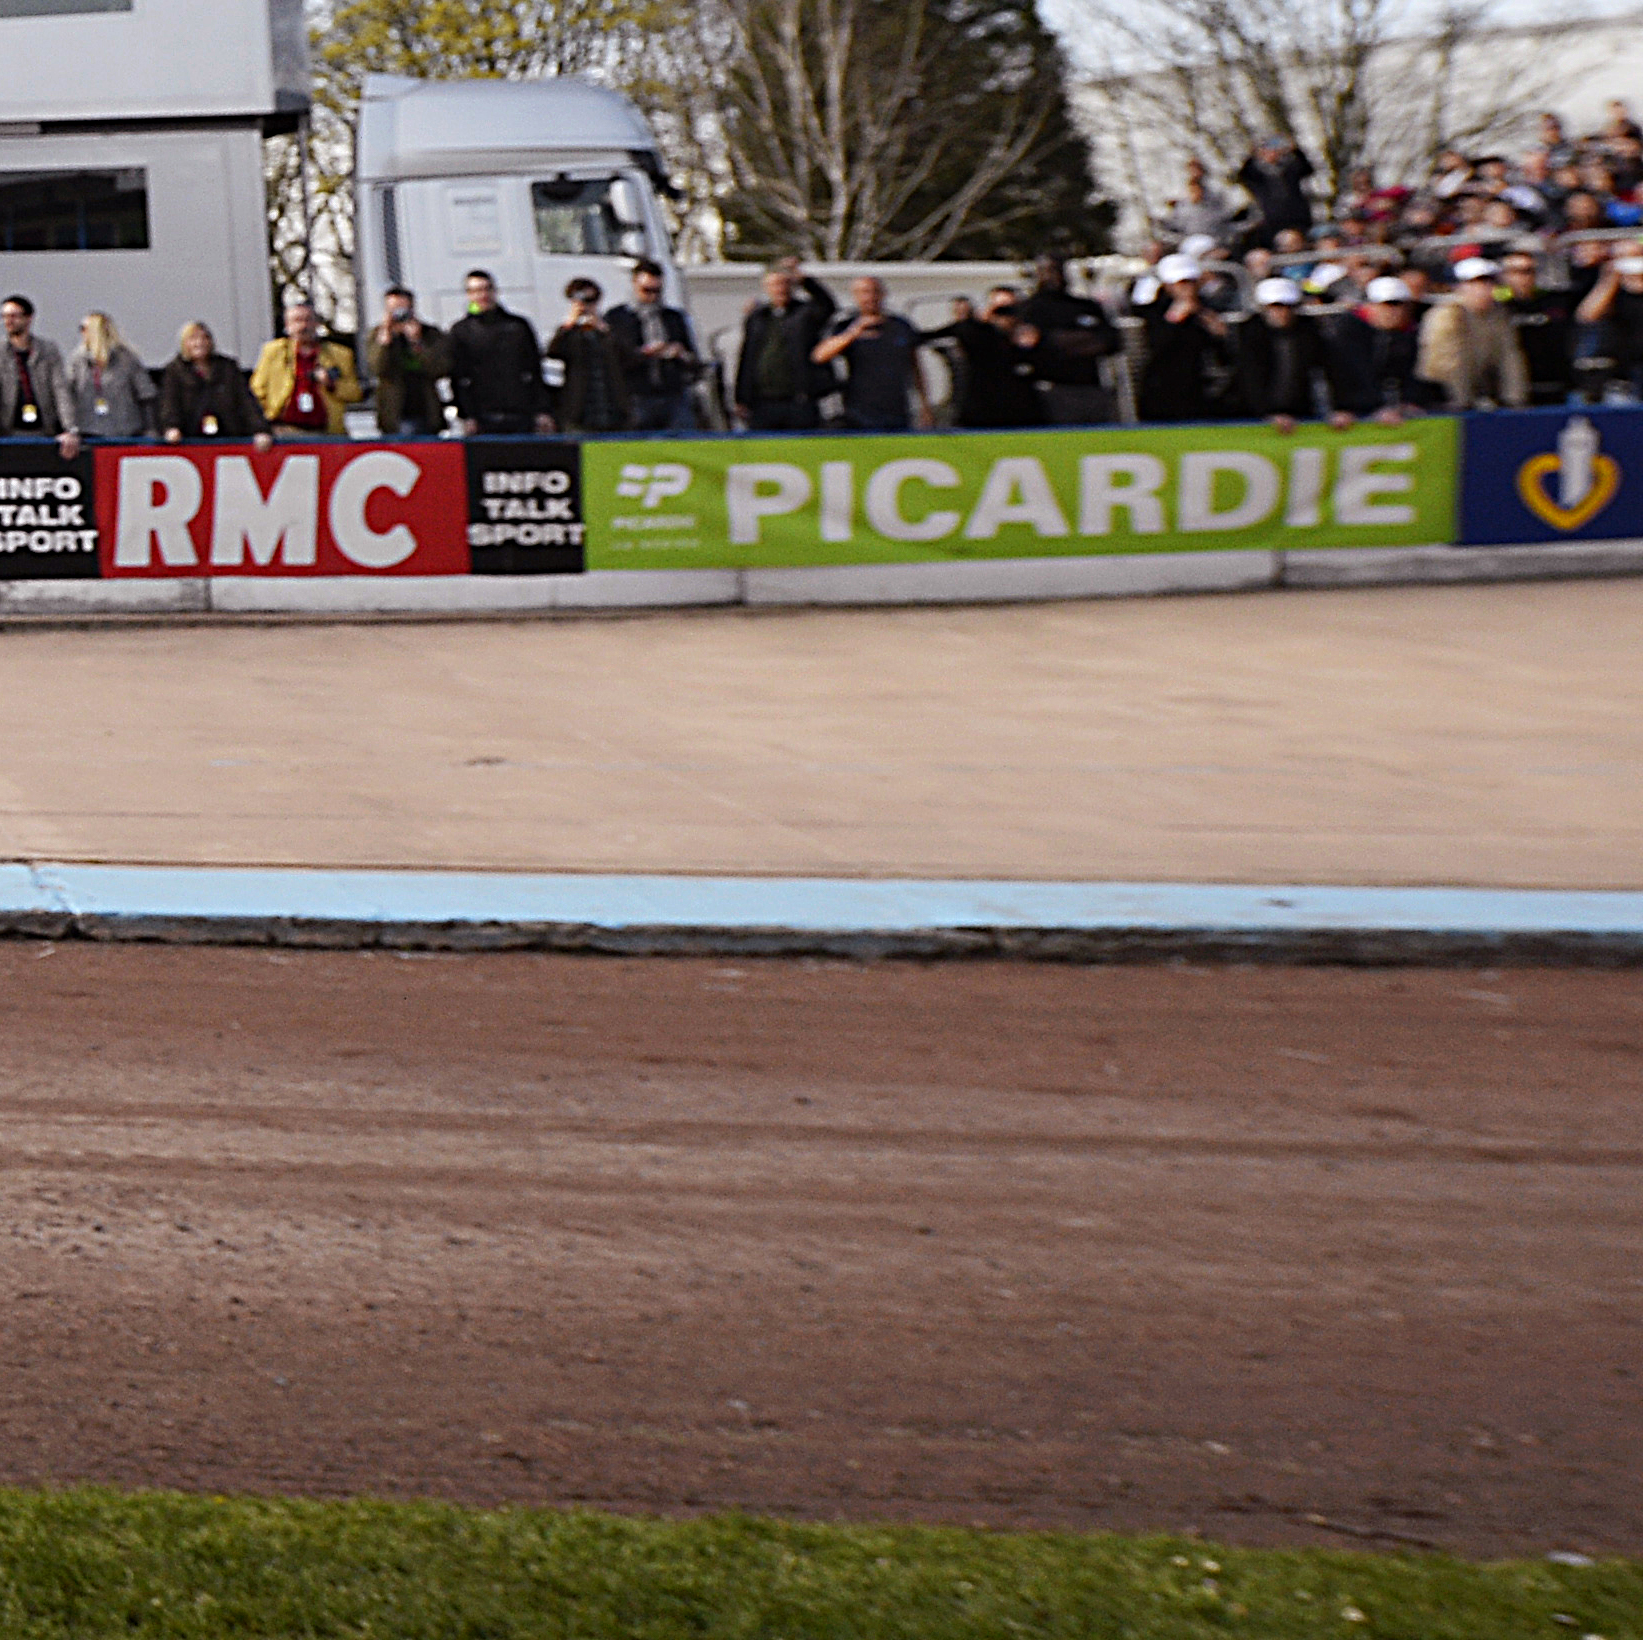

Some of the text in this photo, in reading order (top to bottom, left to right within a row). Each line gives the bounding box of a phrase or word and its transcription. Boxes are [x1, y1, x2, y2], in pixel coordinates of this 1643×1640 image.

[483, 470, 570, 495] INFO
[726, 443, 1419, 545] PICARDIE
[114, 452, 422, 568] RMC
[480, 498, 573, 521] TALK
[467, 523, 586, 547] SPORT
